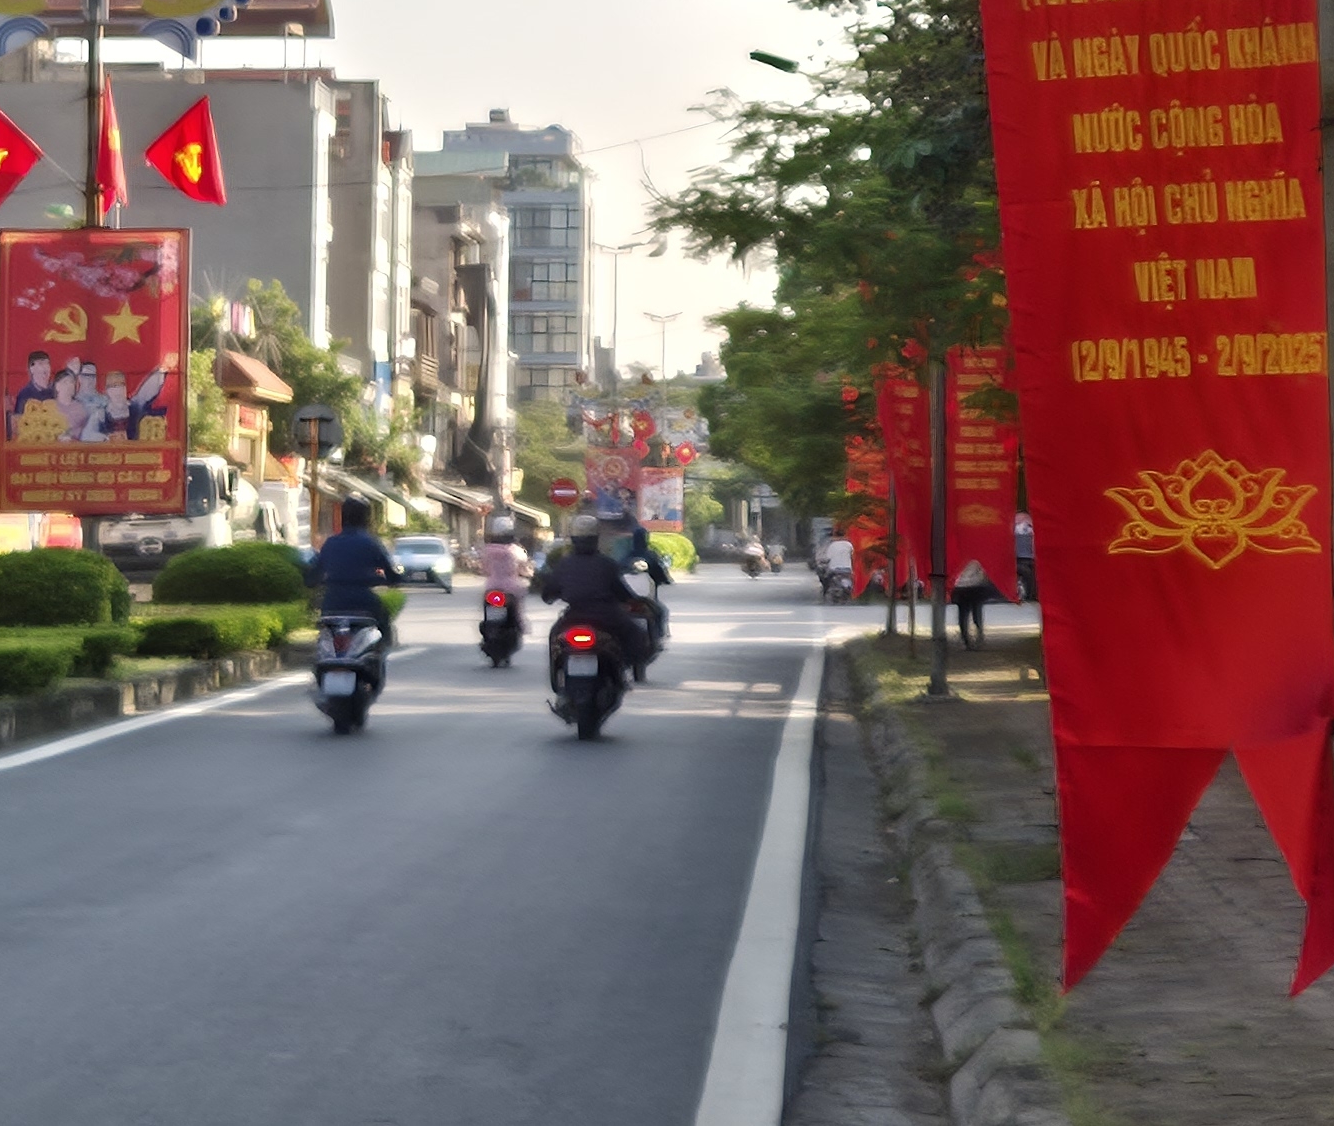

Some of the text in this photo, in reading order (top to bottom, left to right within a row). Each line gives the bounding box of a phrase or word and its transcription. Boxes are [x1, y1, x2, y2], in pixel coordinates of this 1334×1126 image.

[1032, 14, 1317, 81] VÀ NGÀY QUỐC KHÁNH
[1072, 92, 1284, 157] NƯỚC CỘNG HÒA
[1071, 167, 1307, 236] XÃ HỘI CHỦ NGHĨA
[1134, 251, 1258, 311] VIỆT NAM
